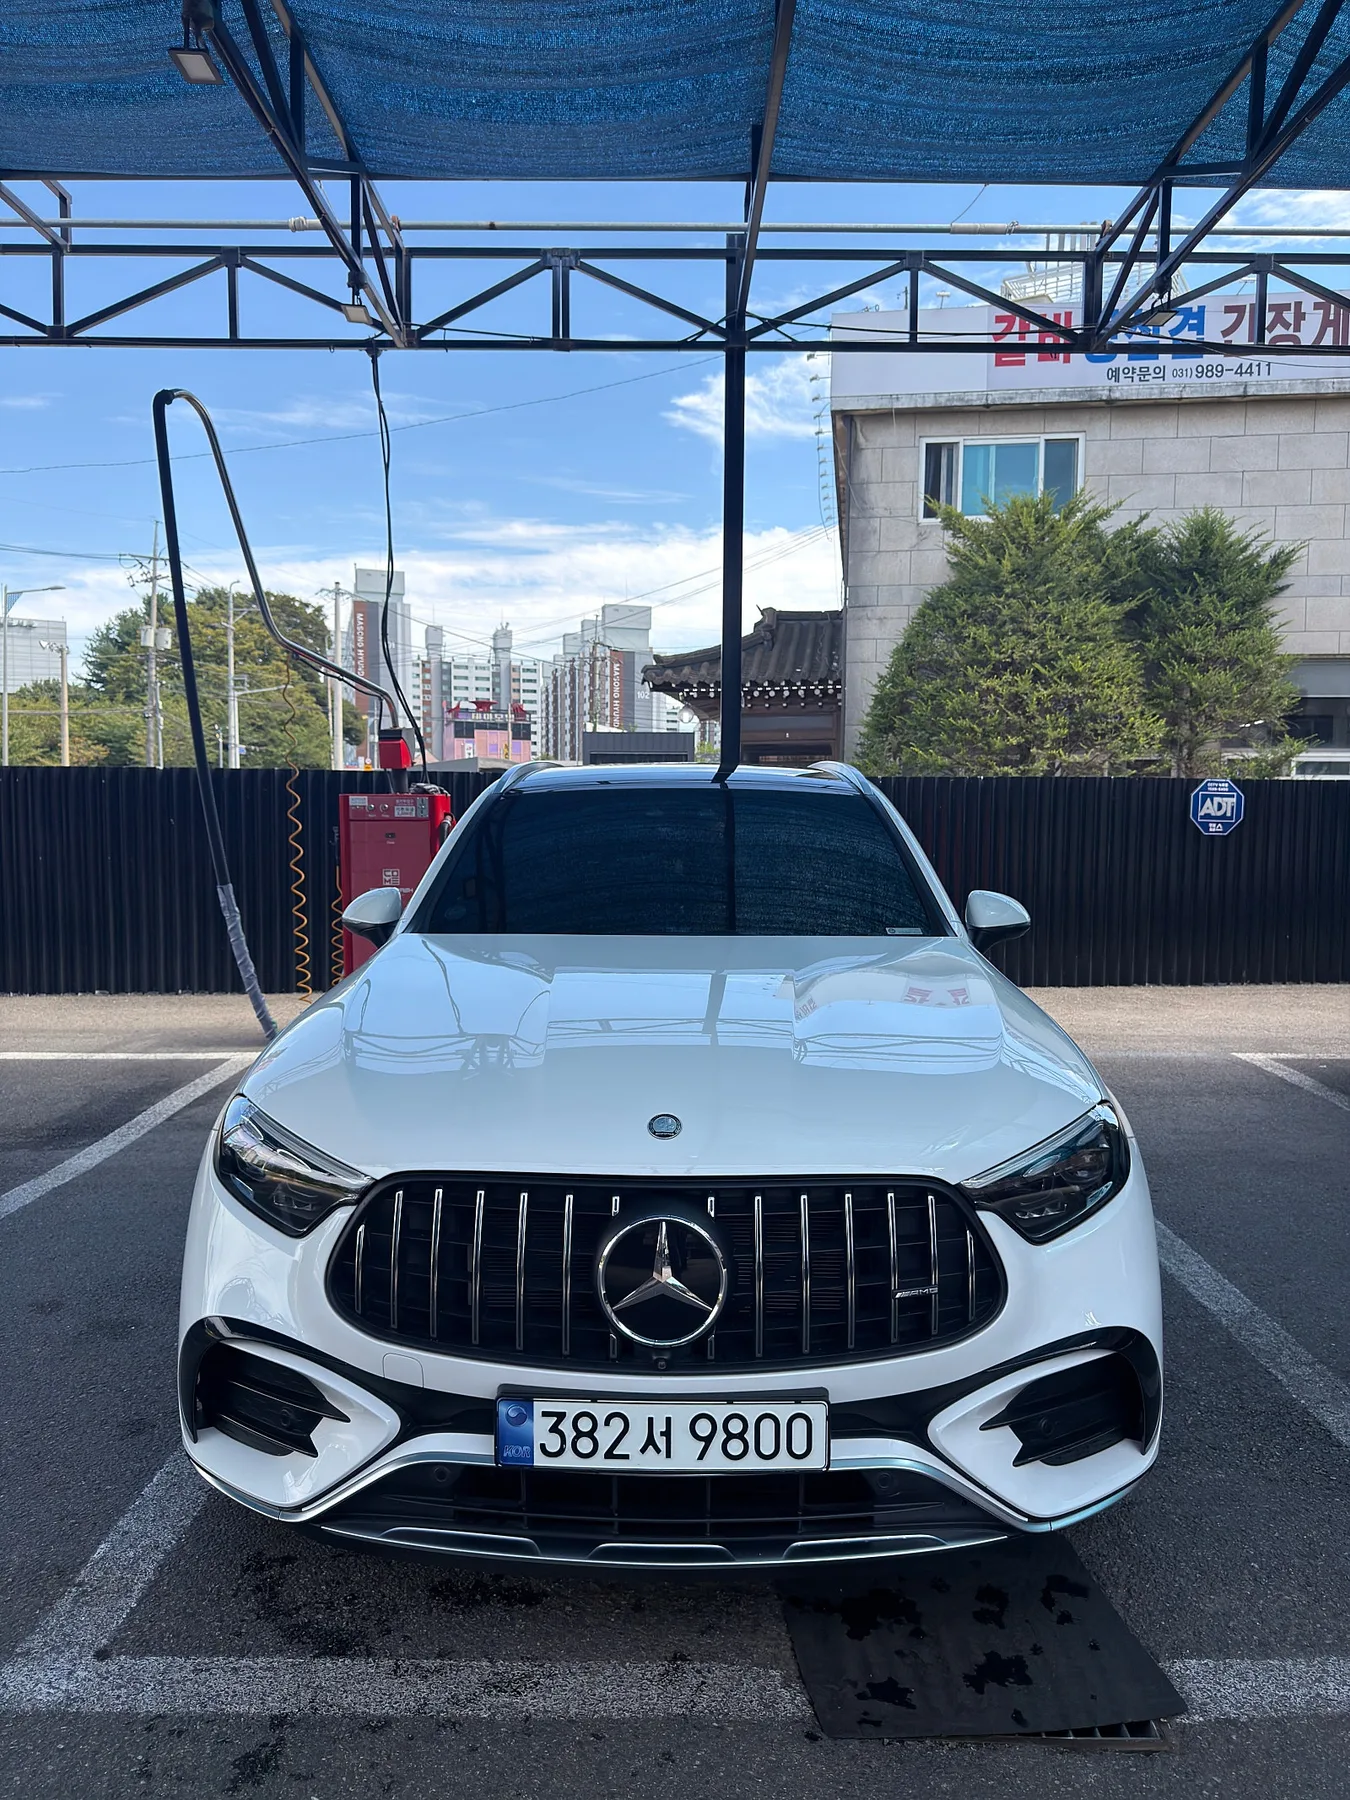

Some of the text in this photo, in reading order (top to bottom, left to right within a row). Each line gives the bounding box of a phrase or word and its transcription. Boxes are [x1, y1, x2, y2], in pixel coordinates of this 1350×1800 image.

[1106, 365, 1166, 383] 예약문의
[613, 664, 621, 698] MASONG
[637, 691, 650, 700] 102
[1199, 797, 1234, 817] ADT
[904, 1287, 938, 1297] AMG
[539, 1411, 813, 1461] 382서 9800
[503, 1445, 531, 1458] KOR
